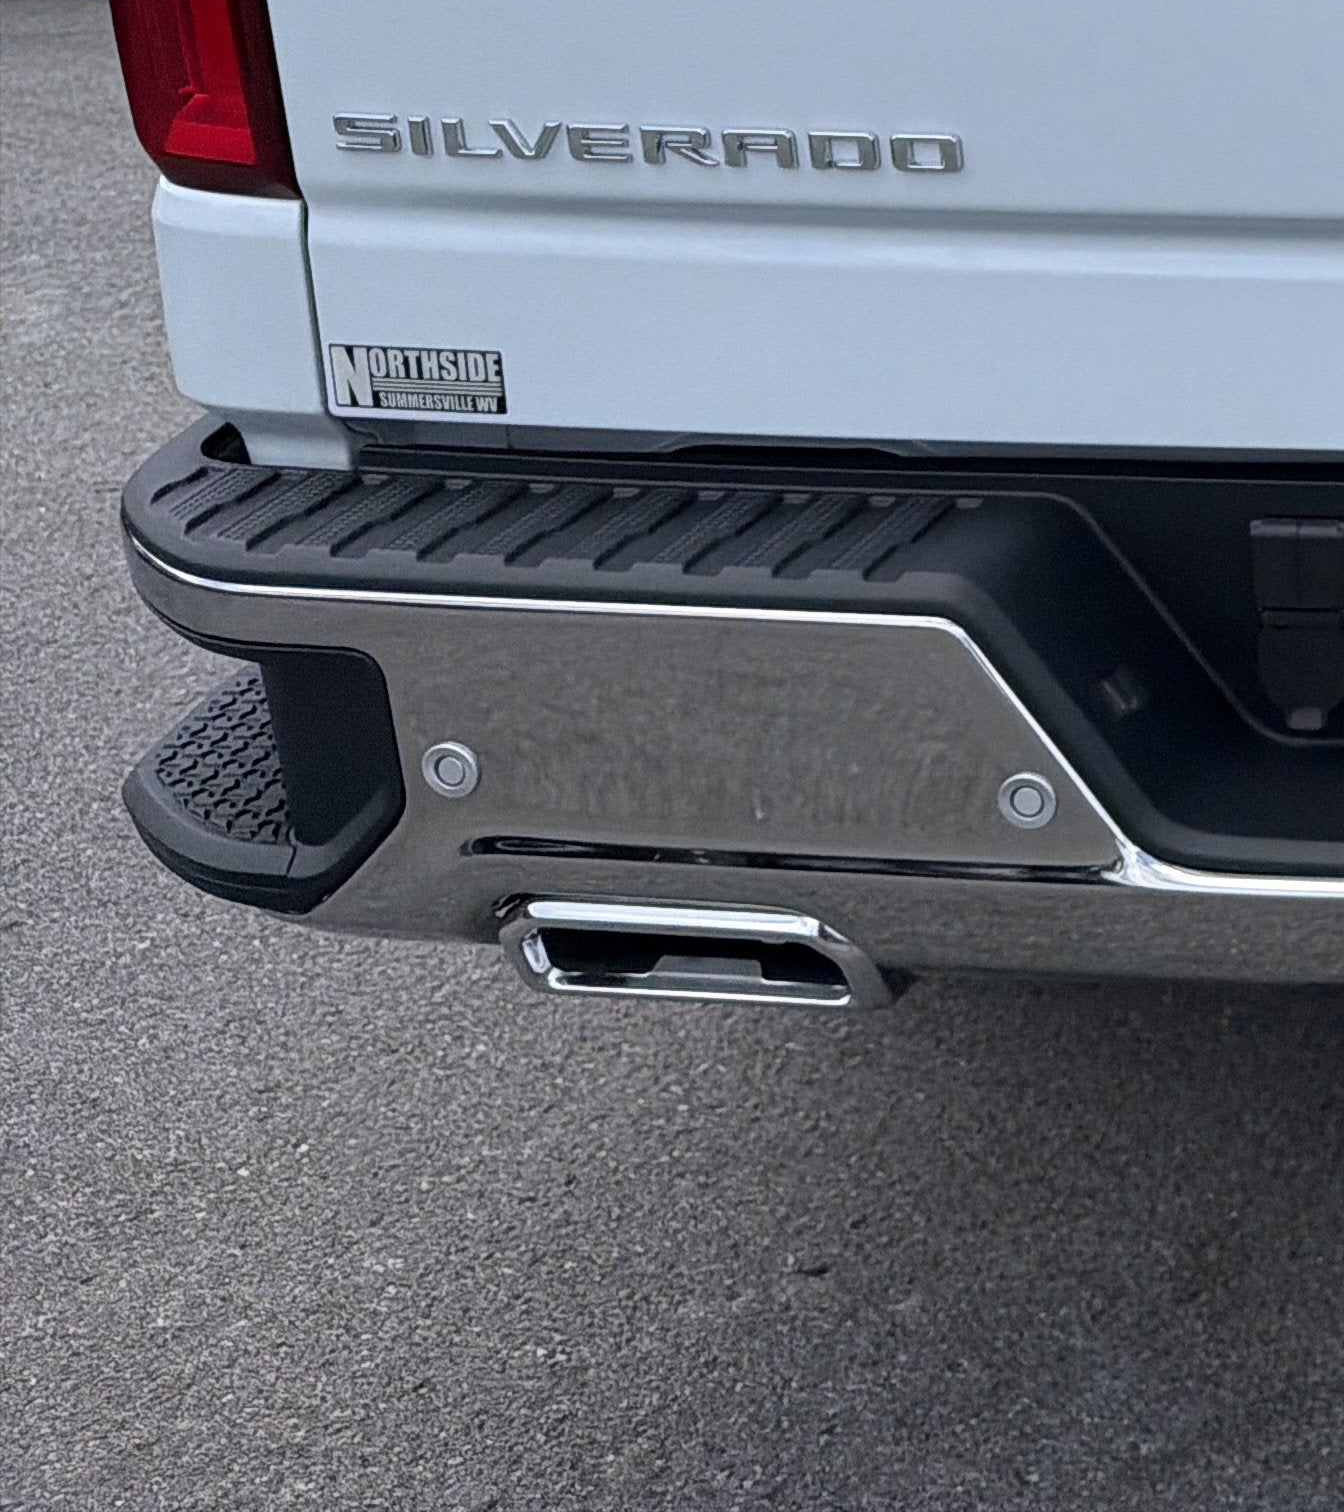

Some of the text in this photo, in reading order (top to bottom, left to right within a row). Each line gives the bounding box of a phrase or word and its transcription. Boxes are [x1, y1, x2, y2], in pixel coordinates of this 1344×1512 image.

[332, 112, 965, 174] SILVERADO
[330, 345, 501, 407] NORTHSIDE
[379, 391, 498, 413] SUMMERSVILLE WV
